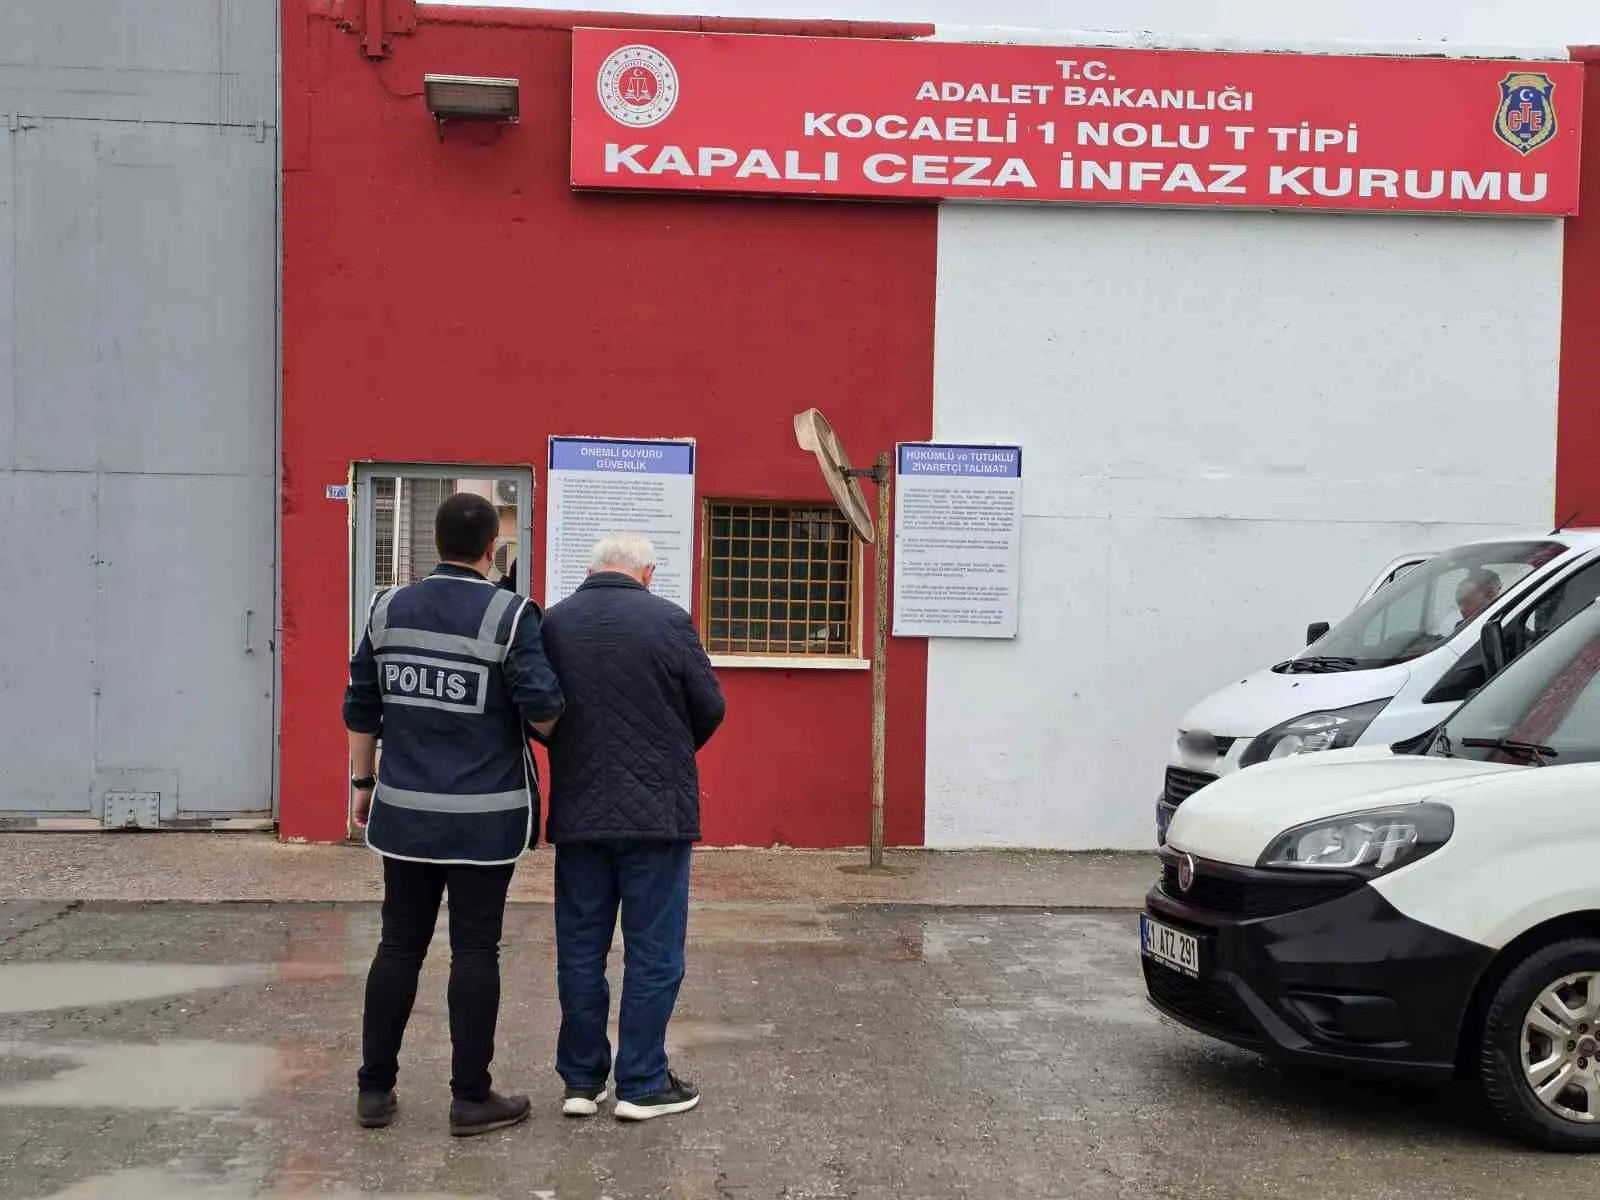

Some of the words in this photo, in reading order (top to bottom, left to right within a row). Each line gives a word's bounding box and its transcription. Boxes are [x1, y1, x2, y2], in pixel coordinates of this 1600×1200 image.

[1055, 59, 1116, 83] T.C.
[915, 81, 1054, 106] ADALET
[1063, 84, 1253, 113] BAKANLIĞI
[804, 111, 1017, 144] KOCAELİ
[1037, 121, 1055, 145] 1
[1077, 121, 1210, 151] NOLU
[1226, 126, 1255, 151] T
[1267, 122, 1358, 154] TİPİ
[604, 143, 839, 182] KAPALI
[862, 153, 1038, 188] CEZA
[1059, 151, 1247, 194] İNFAZ
[1269, 165, 1548, 203] KURUMU
[1160, 927, 1176, 959] ATZ
[1180, 935, 1196, 968] 291
